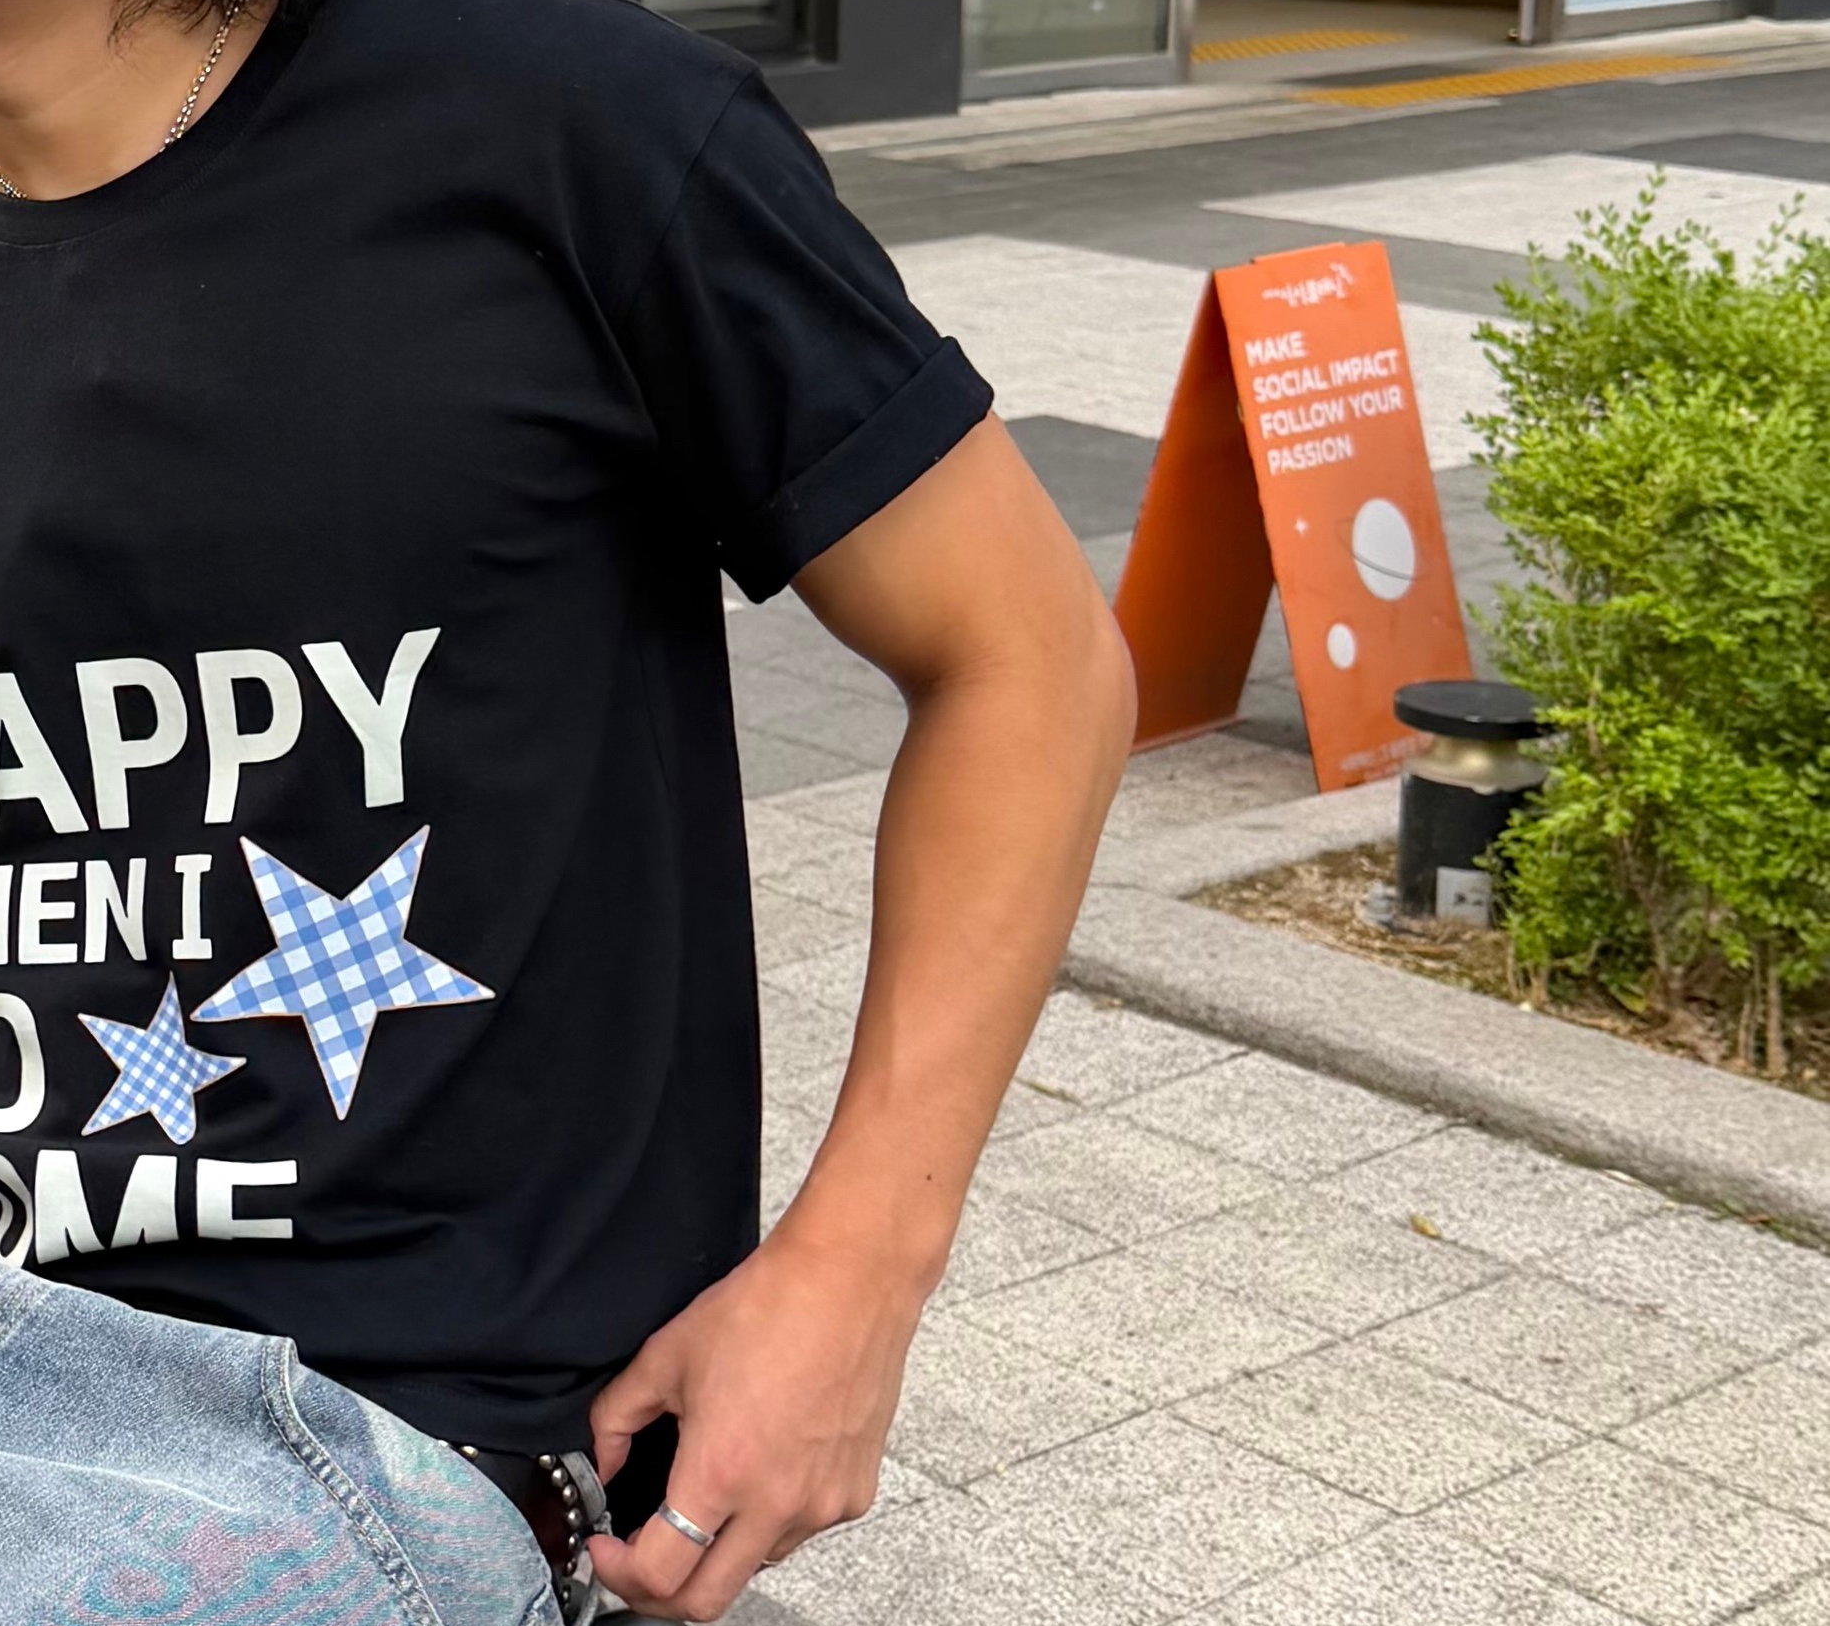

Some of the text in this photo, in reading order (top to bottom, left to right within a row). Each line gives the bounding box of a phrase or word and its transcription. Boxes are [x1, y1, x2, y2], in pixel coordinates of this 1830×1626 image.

[1245, 331, 1307, 367] MAKE
[1252, 348, 1399, 404] SOCIAL IMPACT
[1260, 384, 1404, 440] FOLLOW YOUR
[1266, 433, 1354, 476] PASSION
[172, 854, 213, 960] I
